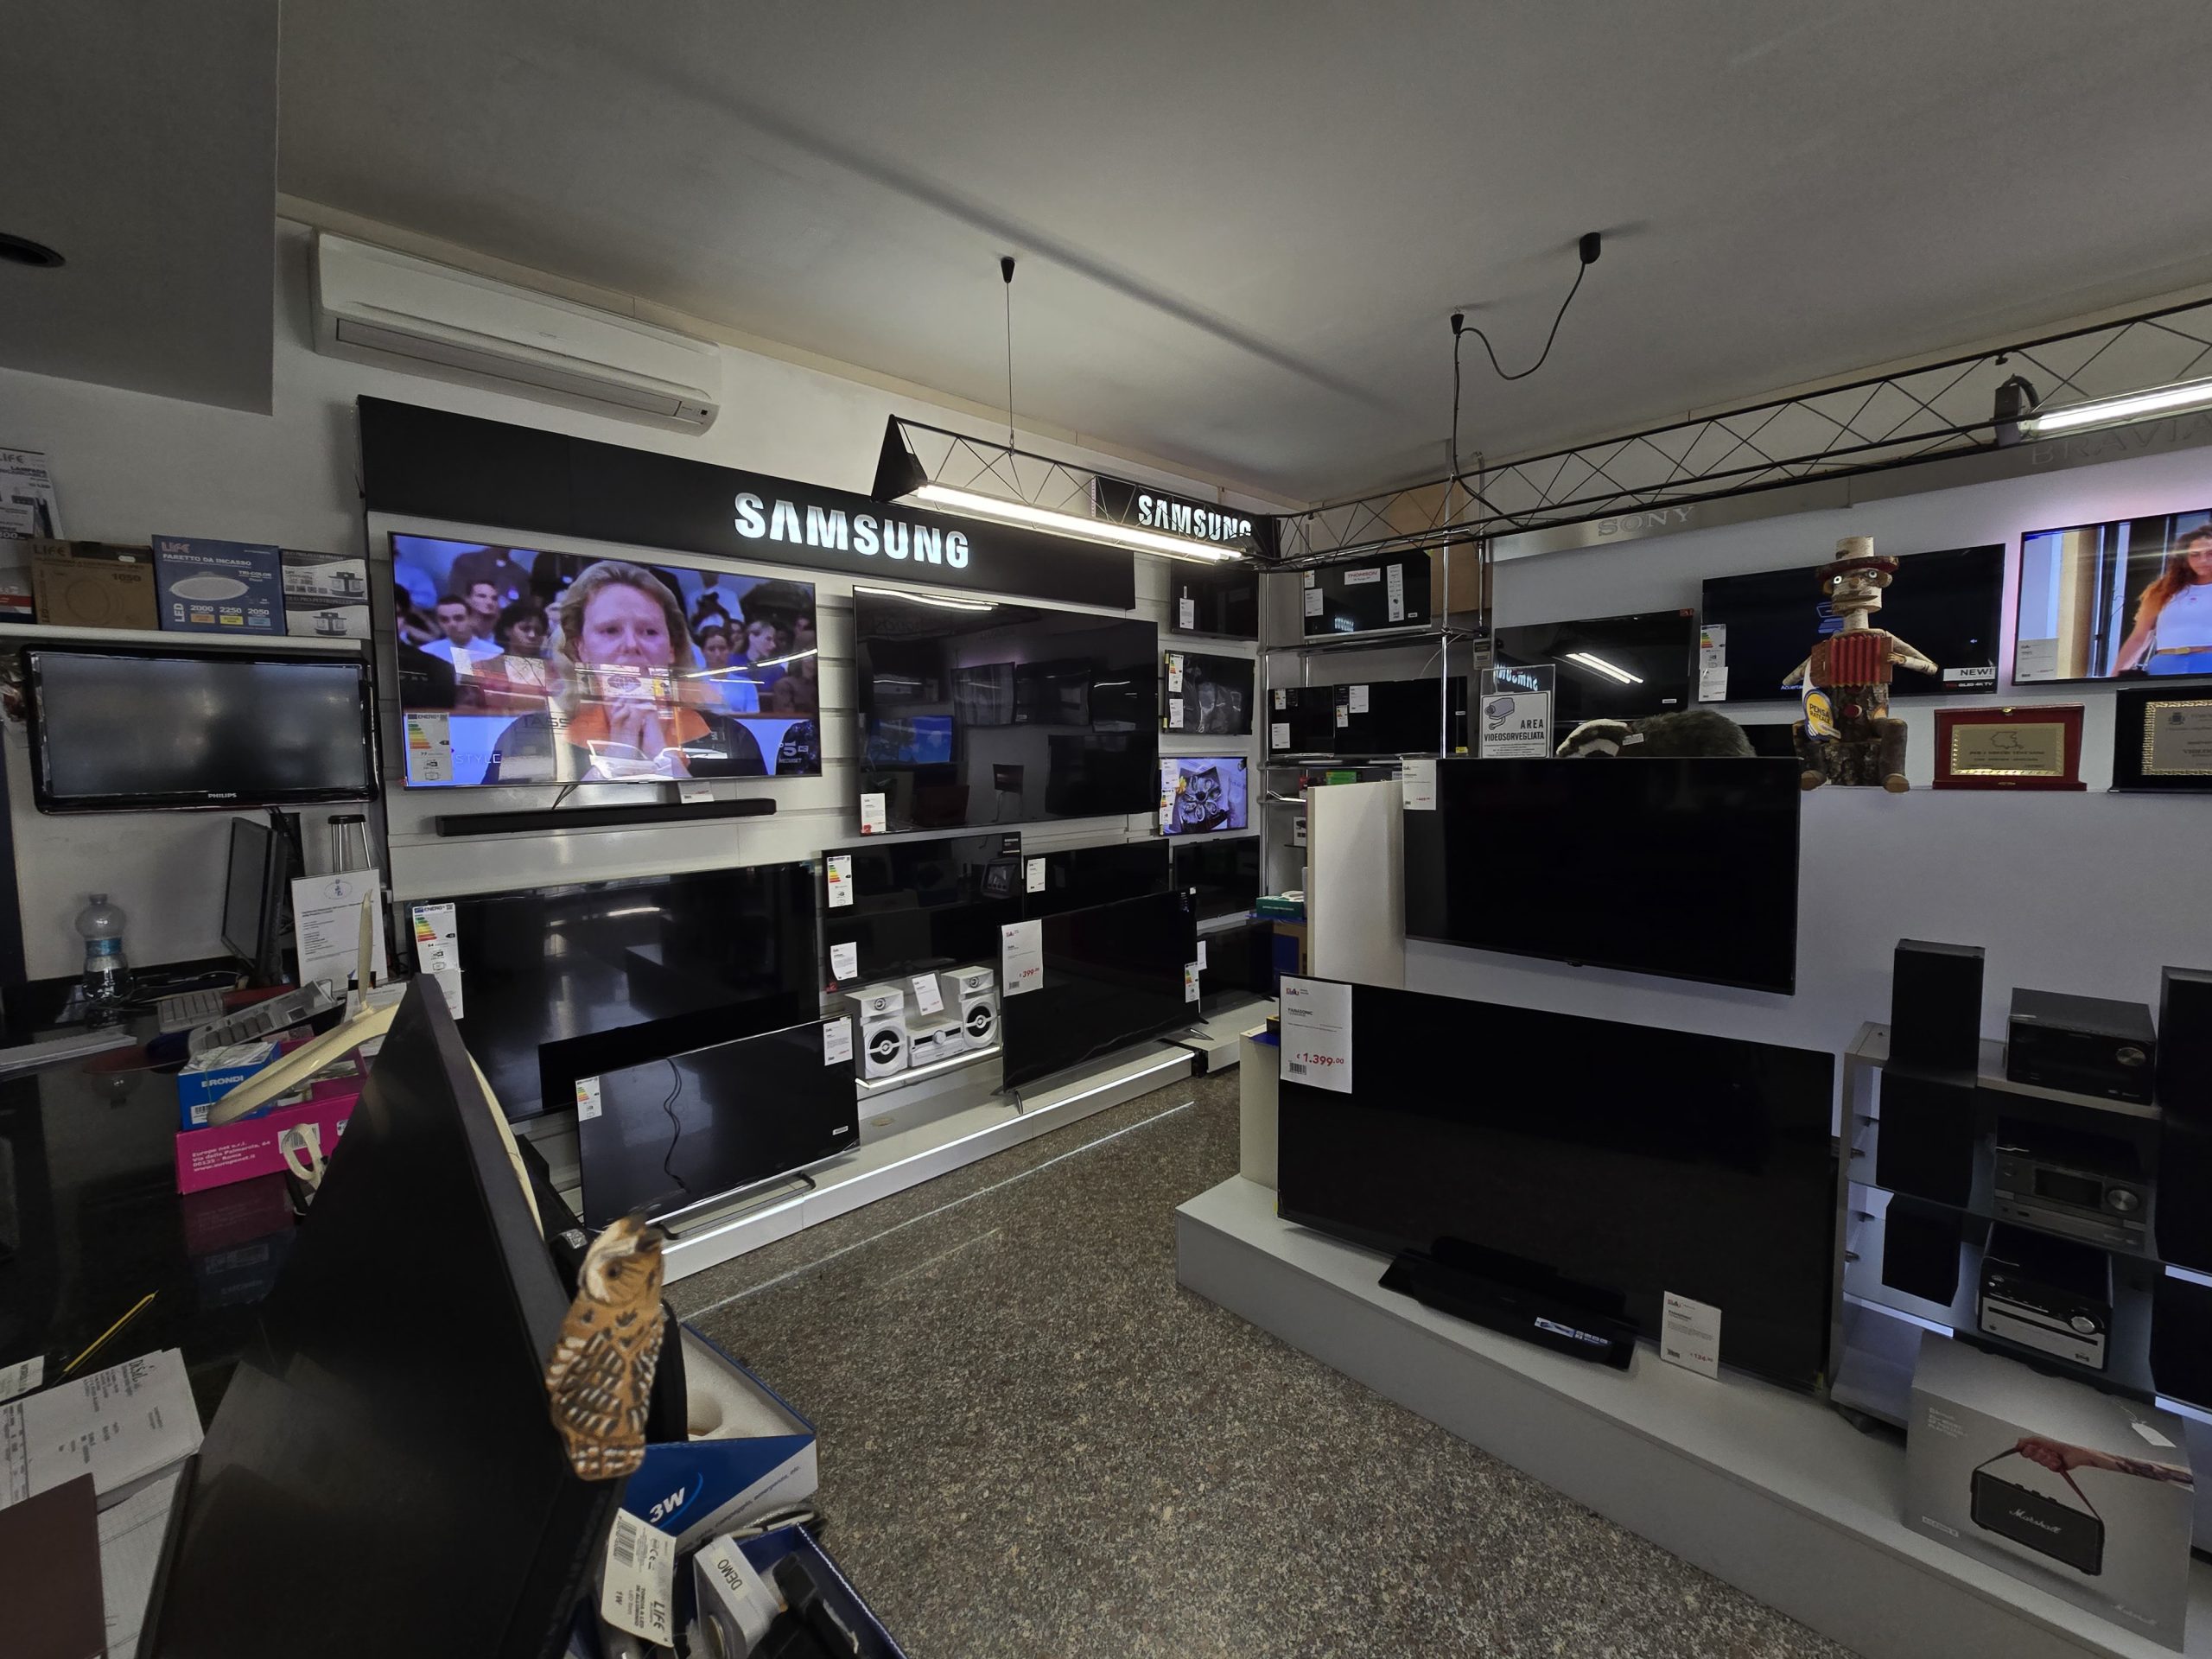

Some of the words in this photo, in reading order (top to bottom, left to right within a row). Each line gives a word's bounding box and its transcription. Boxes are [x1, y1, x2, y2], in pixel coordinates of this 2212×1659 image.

[1137, 495, 1252, 542] SAMSUNG
[1598, 505, 1697, 537] SONY
[734, 492, 969, 569] SAMSUNG
[33, 544, 66, 556] LIFE
[161, 542, 190, 553] LIFE
[162, 553, 200, 563] FARETTO
[215, 558, 252, 567] INCASSO
[174, 603, 186, 622] LED
[1809, 703, 1830, 717] PENSA
[1520, 719, 1544, 729] AREA
[1484, 731, 1545, 741] VIDEOSORVEGLIATA
[1303, 1052, 1344, 1066] 1.399.00
[200, 1076, 244, 1088] BRONDI
[649, 1487, 685, 1523] 3W
[2009, 1508, 2063, 1534] Marshall
[718, 1559, 743, 1591] DEMO
[652, 1601, 666, 1631] LIFE
[2111, 1603, 2158, 1627] Marshall
